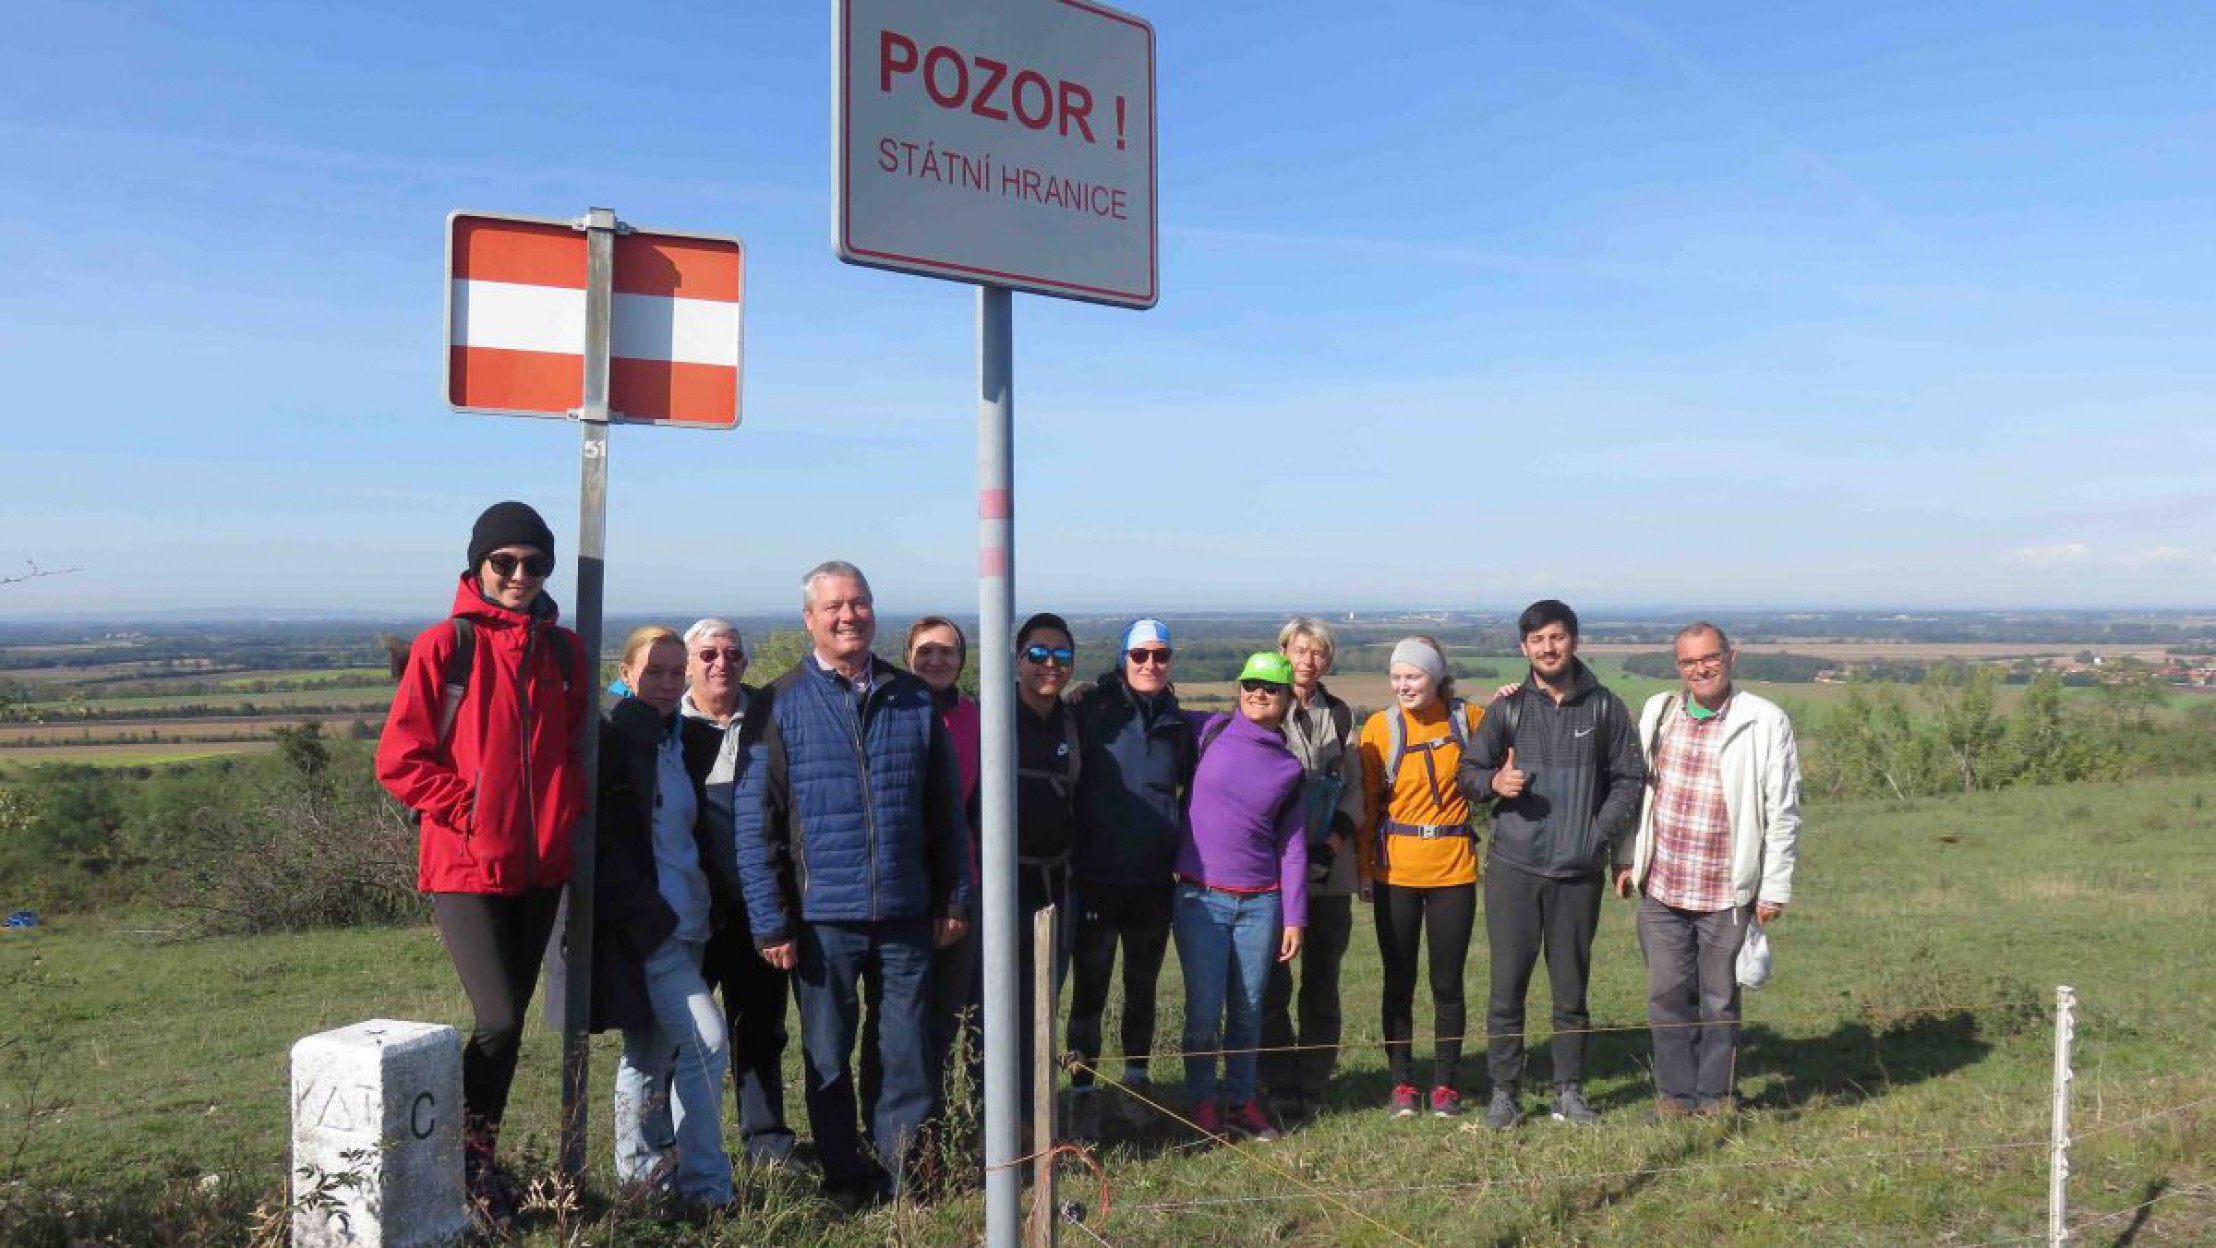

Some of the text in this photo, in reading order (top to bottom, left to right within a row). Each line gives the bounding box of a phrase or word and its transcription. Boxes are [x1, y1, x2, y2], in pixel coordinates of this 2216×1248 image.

[880, 29, 1126, 150] POZOR !
[878, 137, 1127, 221] STÁTNÍ HRANICE
[411, 1090, 436, 1140] C
